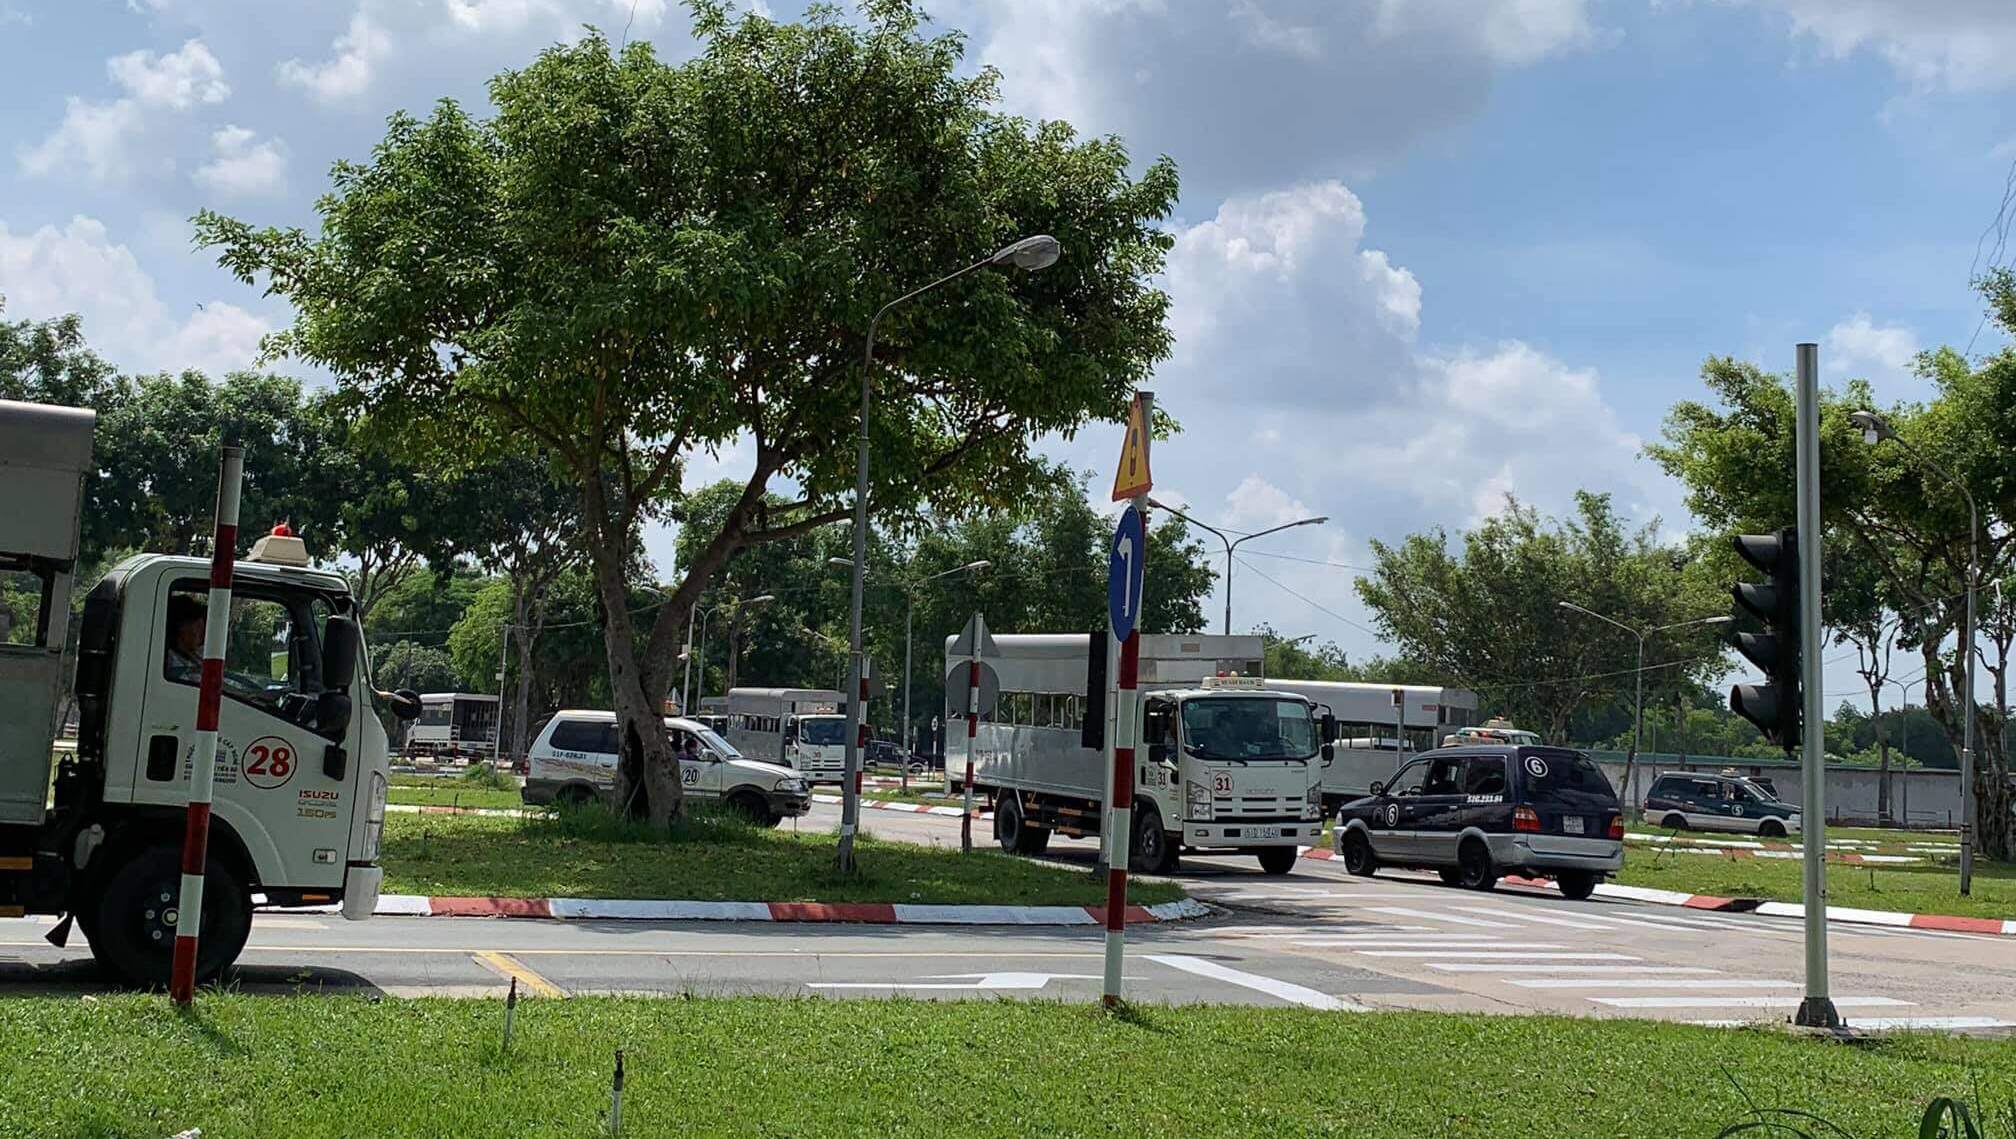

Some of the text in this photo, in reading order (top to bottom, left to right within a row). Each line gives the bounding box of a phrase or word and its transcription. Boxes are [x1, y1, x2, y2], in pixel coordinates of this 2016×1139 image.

[247, 745, 290, 777] 28
[1530, 759, 1543, 774] 6
[685, 769, 698, 782] 20
[1158, 771, 1166, 785] 31
[1215, 777, 1231, 791] 31
[299, 789, 340, 800] ISUZU
[1388, 806, 1396, 823] 6
